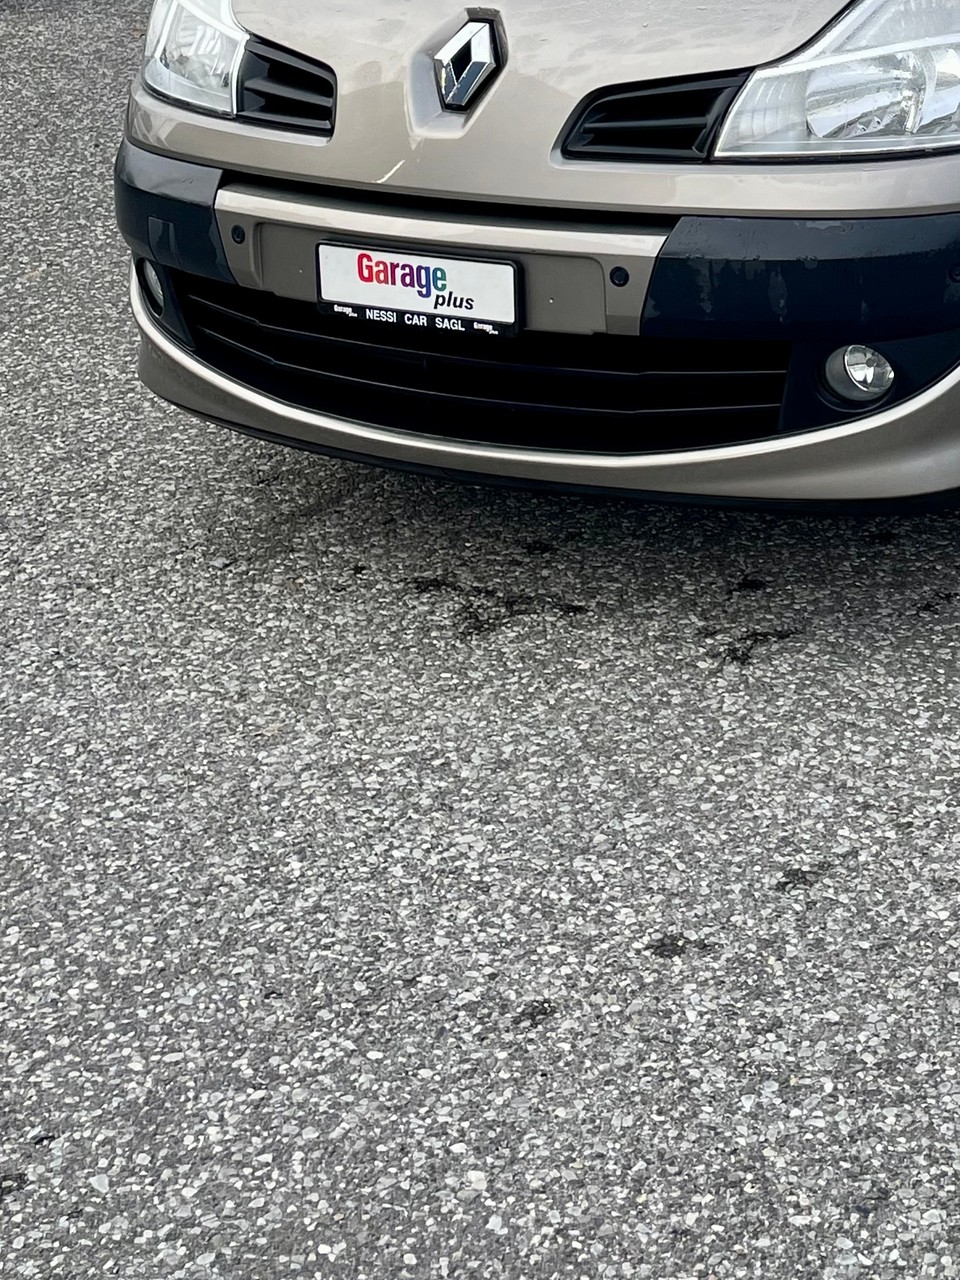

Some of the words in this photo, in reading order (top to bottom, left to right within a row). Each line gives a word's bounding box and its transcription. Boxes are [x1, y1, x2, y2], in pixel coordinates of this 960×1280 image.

[357, 253, 447, 298] Garage
[434, 291, 474, 310] plus
[366, 308, 397, 323] NESSI
[404, 313, 428, 327] CAR
[435, 317, 465, 332] SAGL
